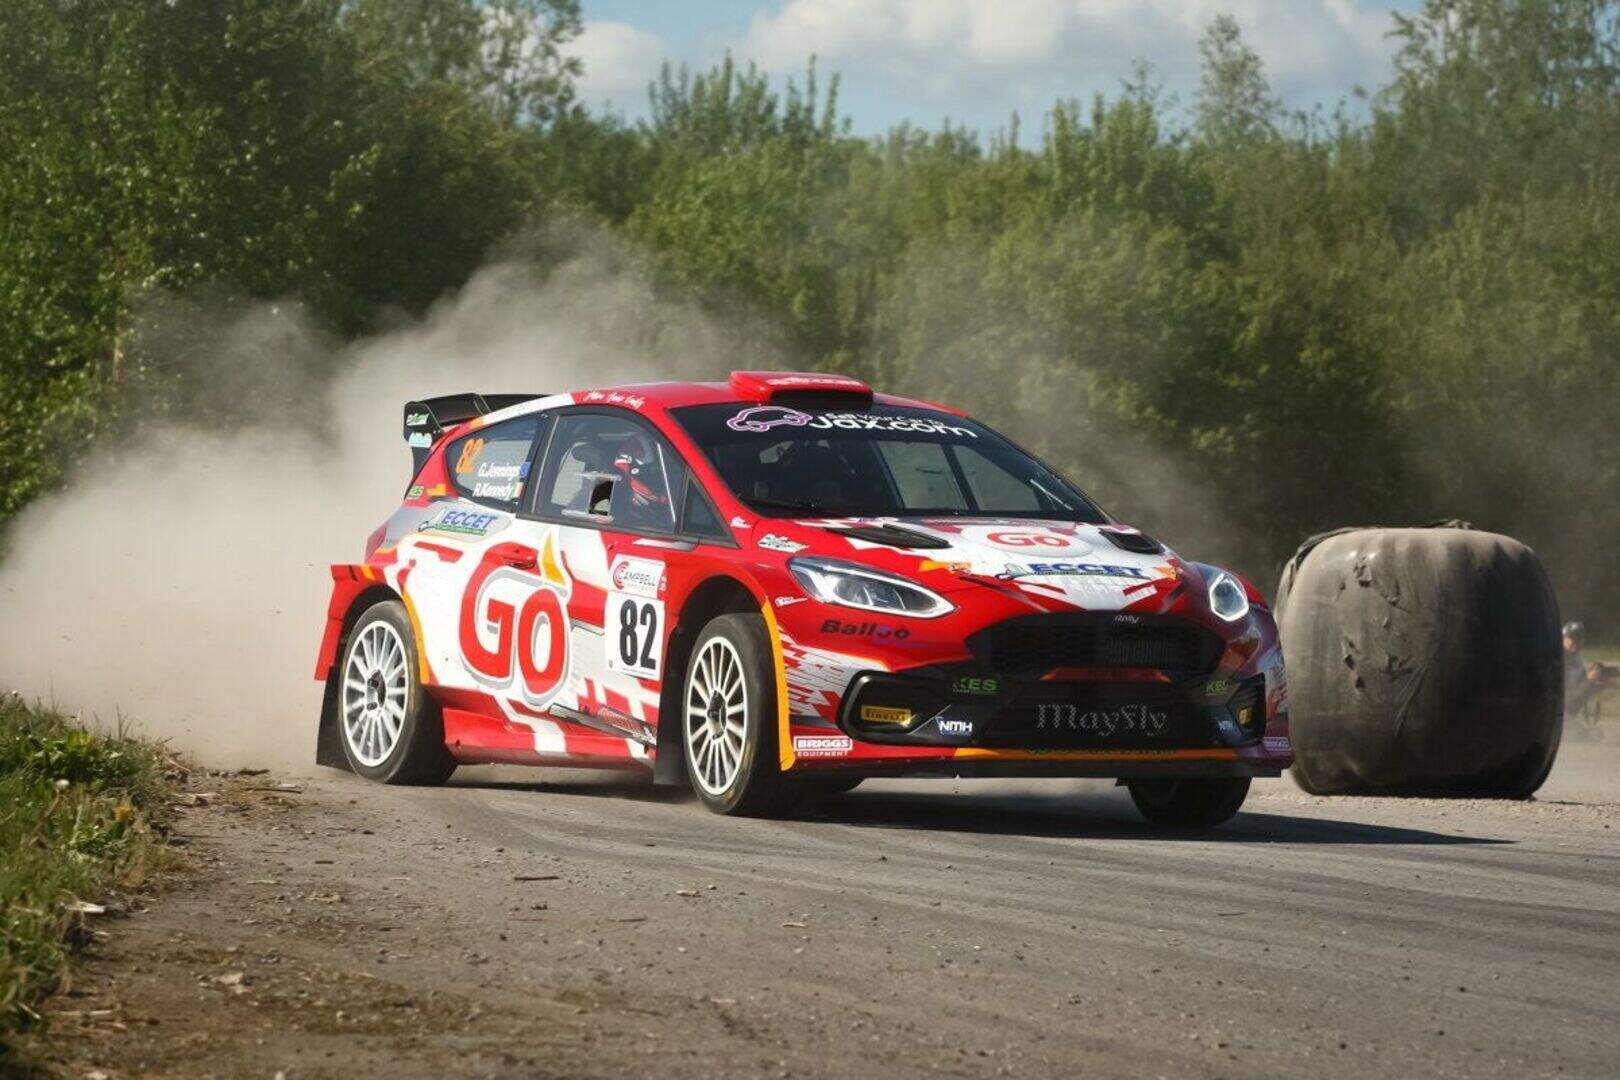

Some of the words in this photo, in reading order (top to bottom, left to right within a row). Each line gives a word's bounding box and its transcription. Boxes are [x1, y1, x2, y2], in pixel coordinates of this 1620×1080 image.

[441, 511, 498, 529] ECCET
[1028, 563, 1143, 577] ECCET
[619, 599, 657, 670] 82
[797, 739, 849, 749] BRIGGS
